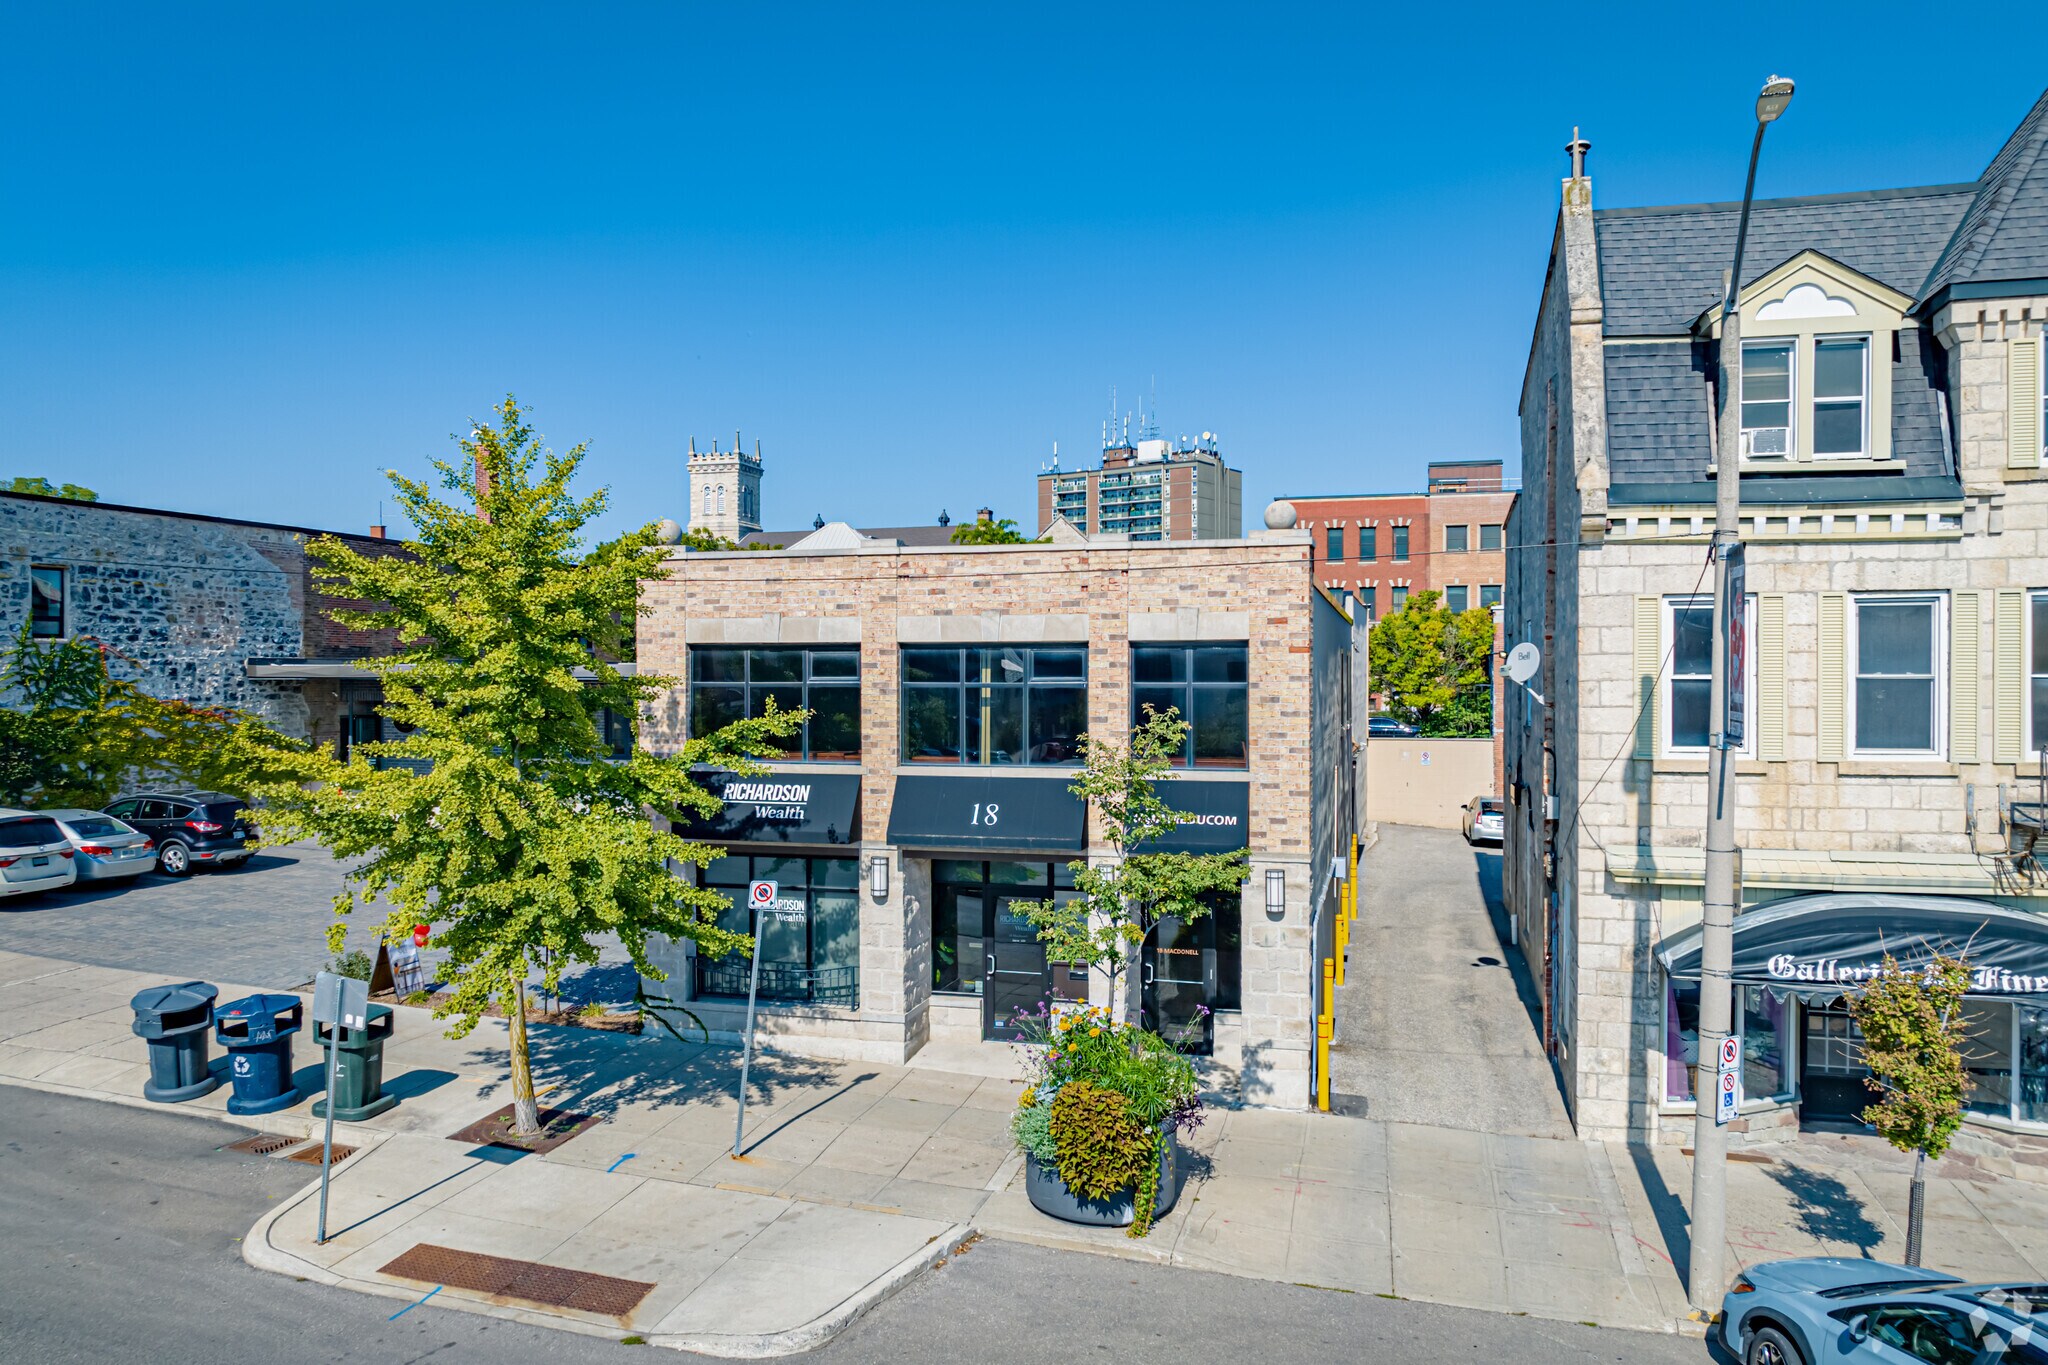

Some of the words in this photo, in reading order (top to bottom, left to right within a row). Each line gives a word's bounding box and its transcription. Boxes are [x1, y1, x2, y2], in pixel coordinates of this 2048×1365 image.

[1518, 651, 1531, 661] Bell
[723, 783, 811, 802] RICHARDSON
[755, 805, 805, 820] Wealth
[970, 803, 999, 826] 18
[775, 912, 805, 922] Wealth
[1164, 948, 1199, 956] MACDONELL
[1970, 965, 2048, 992] Fine
